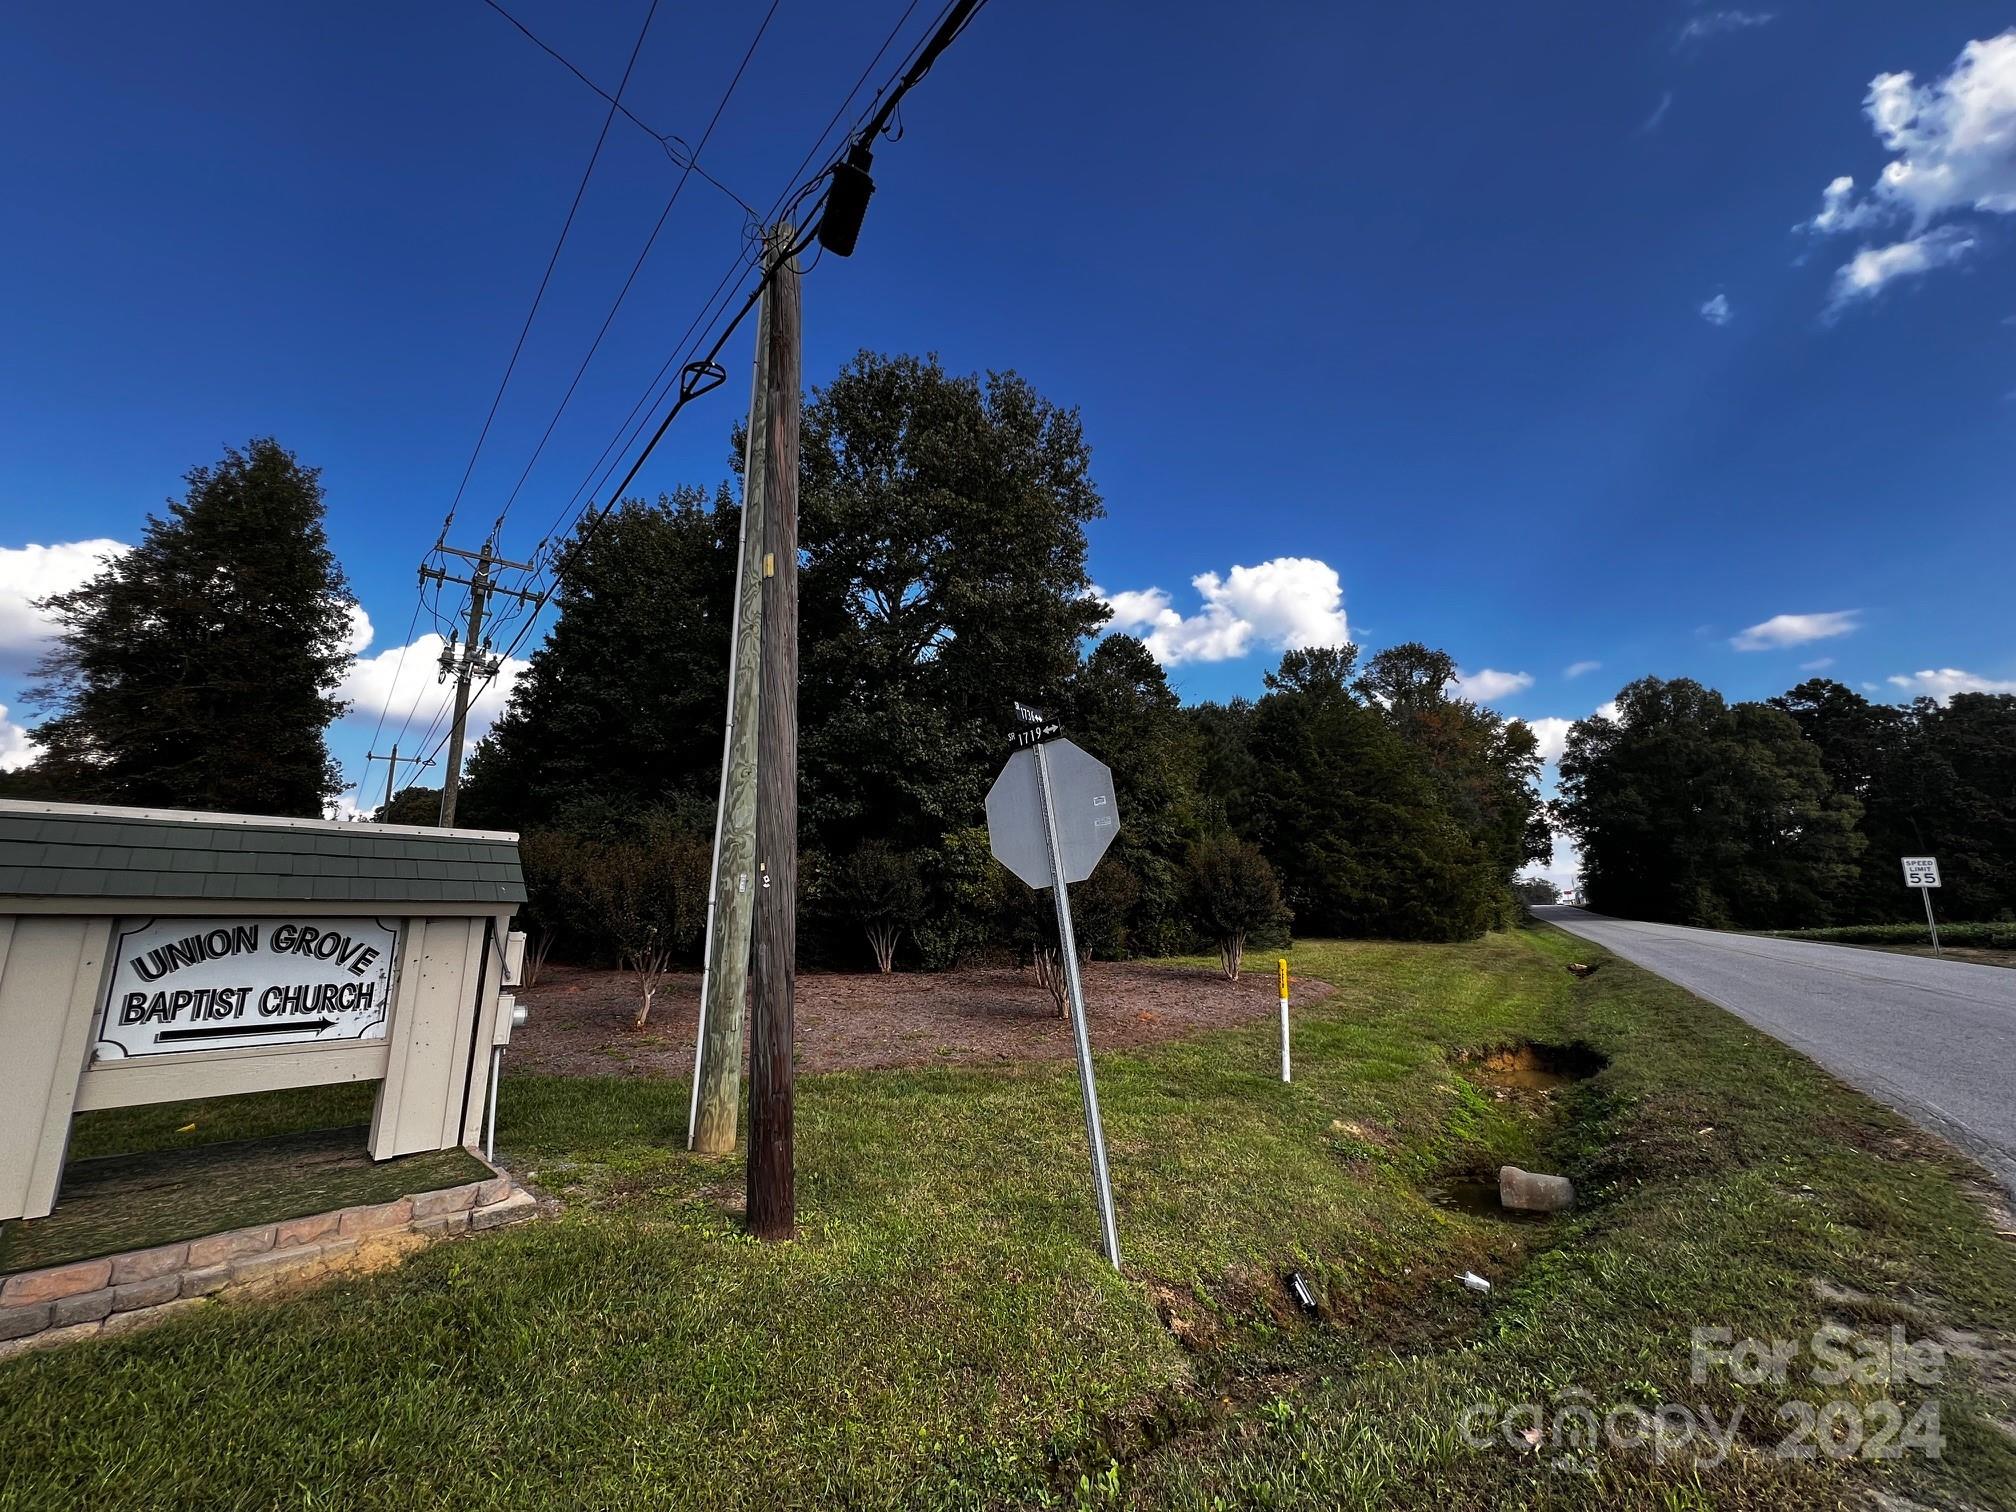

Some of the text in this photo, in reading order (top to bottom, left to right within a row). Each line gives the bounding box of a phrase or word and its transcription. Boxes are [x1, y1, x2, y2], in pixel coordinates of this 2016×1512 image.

[1008, 727, 1041, 746] SR 1719
[1910, 873, 1936, 884] 55
[130, 924, 380, 982] UNION GROVE
[118, 982, 376, 1026] BAPTIST CHURCH
